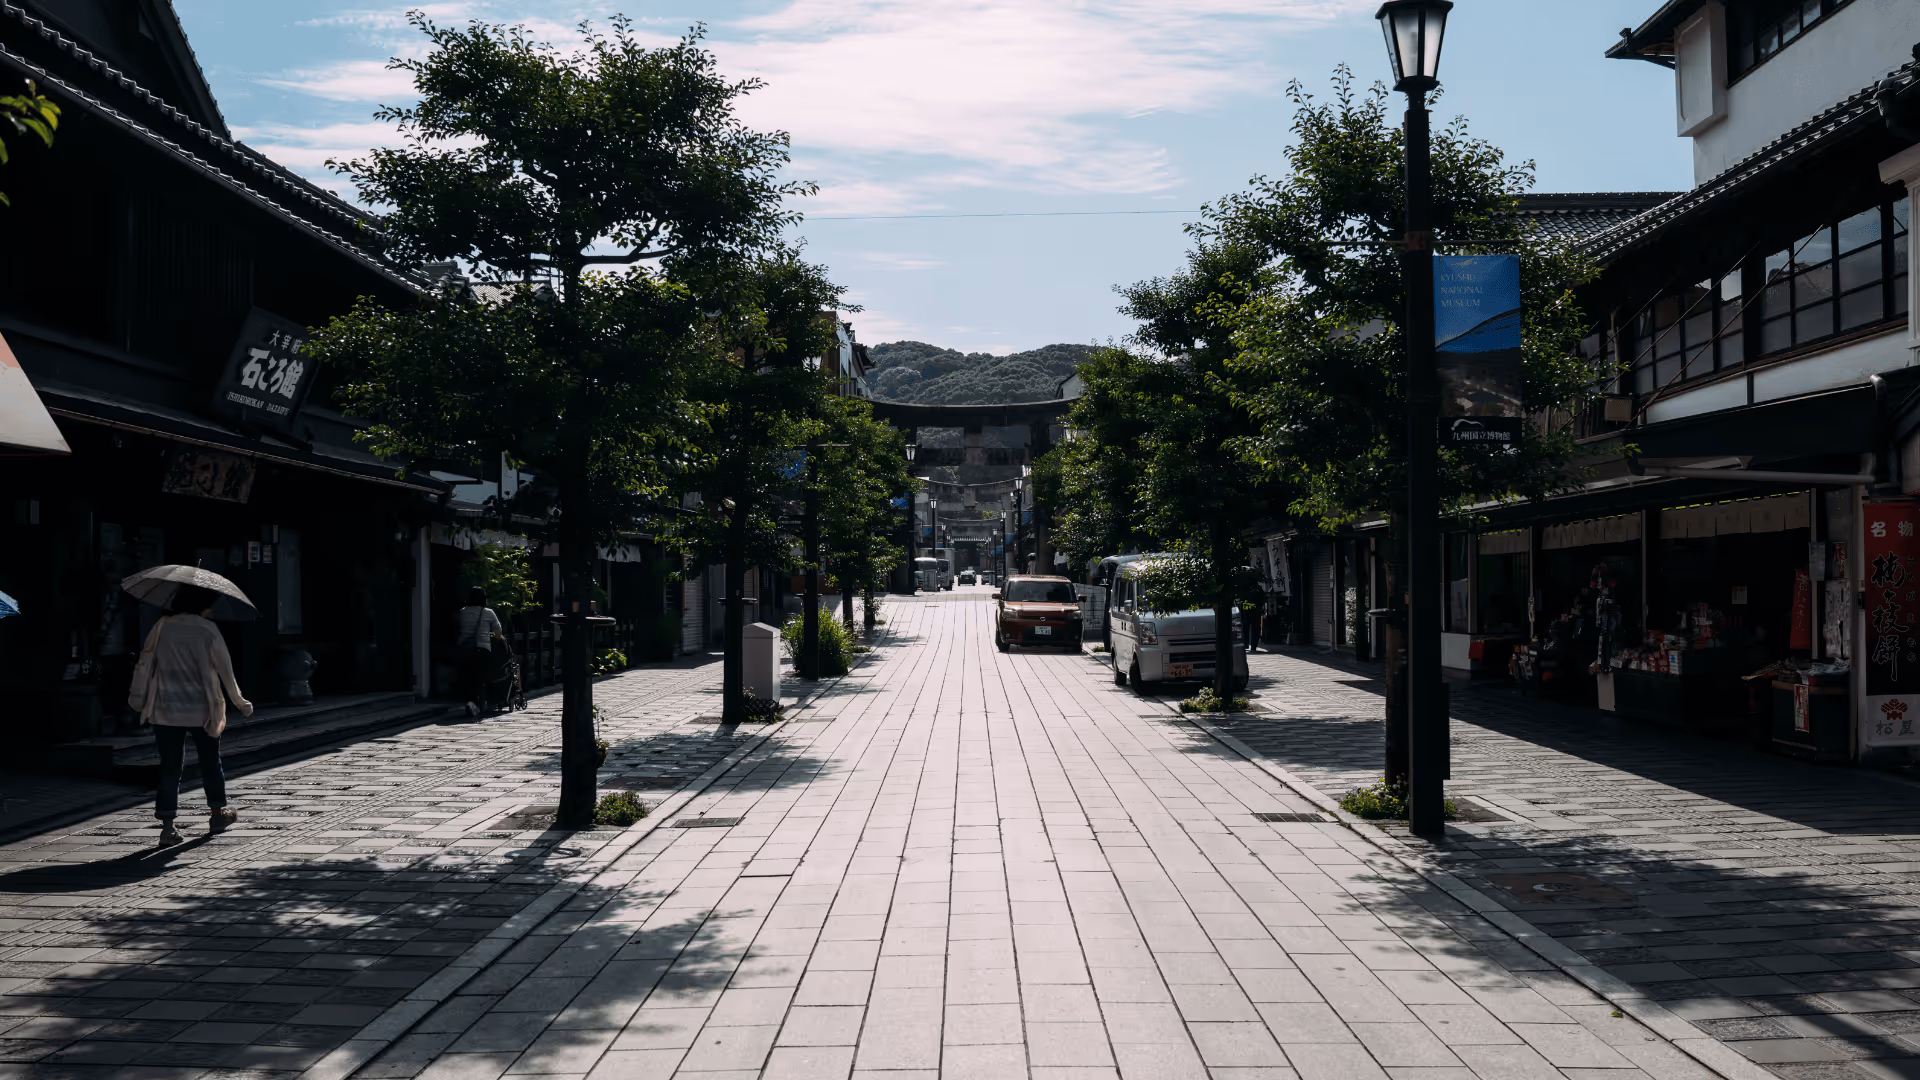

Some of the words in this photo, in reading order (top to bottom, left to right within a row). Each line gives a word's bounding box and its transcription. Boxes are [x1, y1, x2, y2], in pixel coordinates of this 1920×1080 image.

[1440, 286, 1483, 294] NATIONAL
[1440, 299, 1480, 307] MUSEUM
[241, 348, 303, 399] 石ころ館
[1451, 430, 1511, 441] 九州国立博物館
[1870, 520, 1913, 537] 名物
[1875, 719, 1915, 737] 松屋
